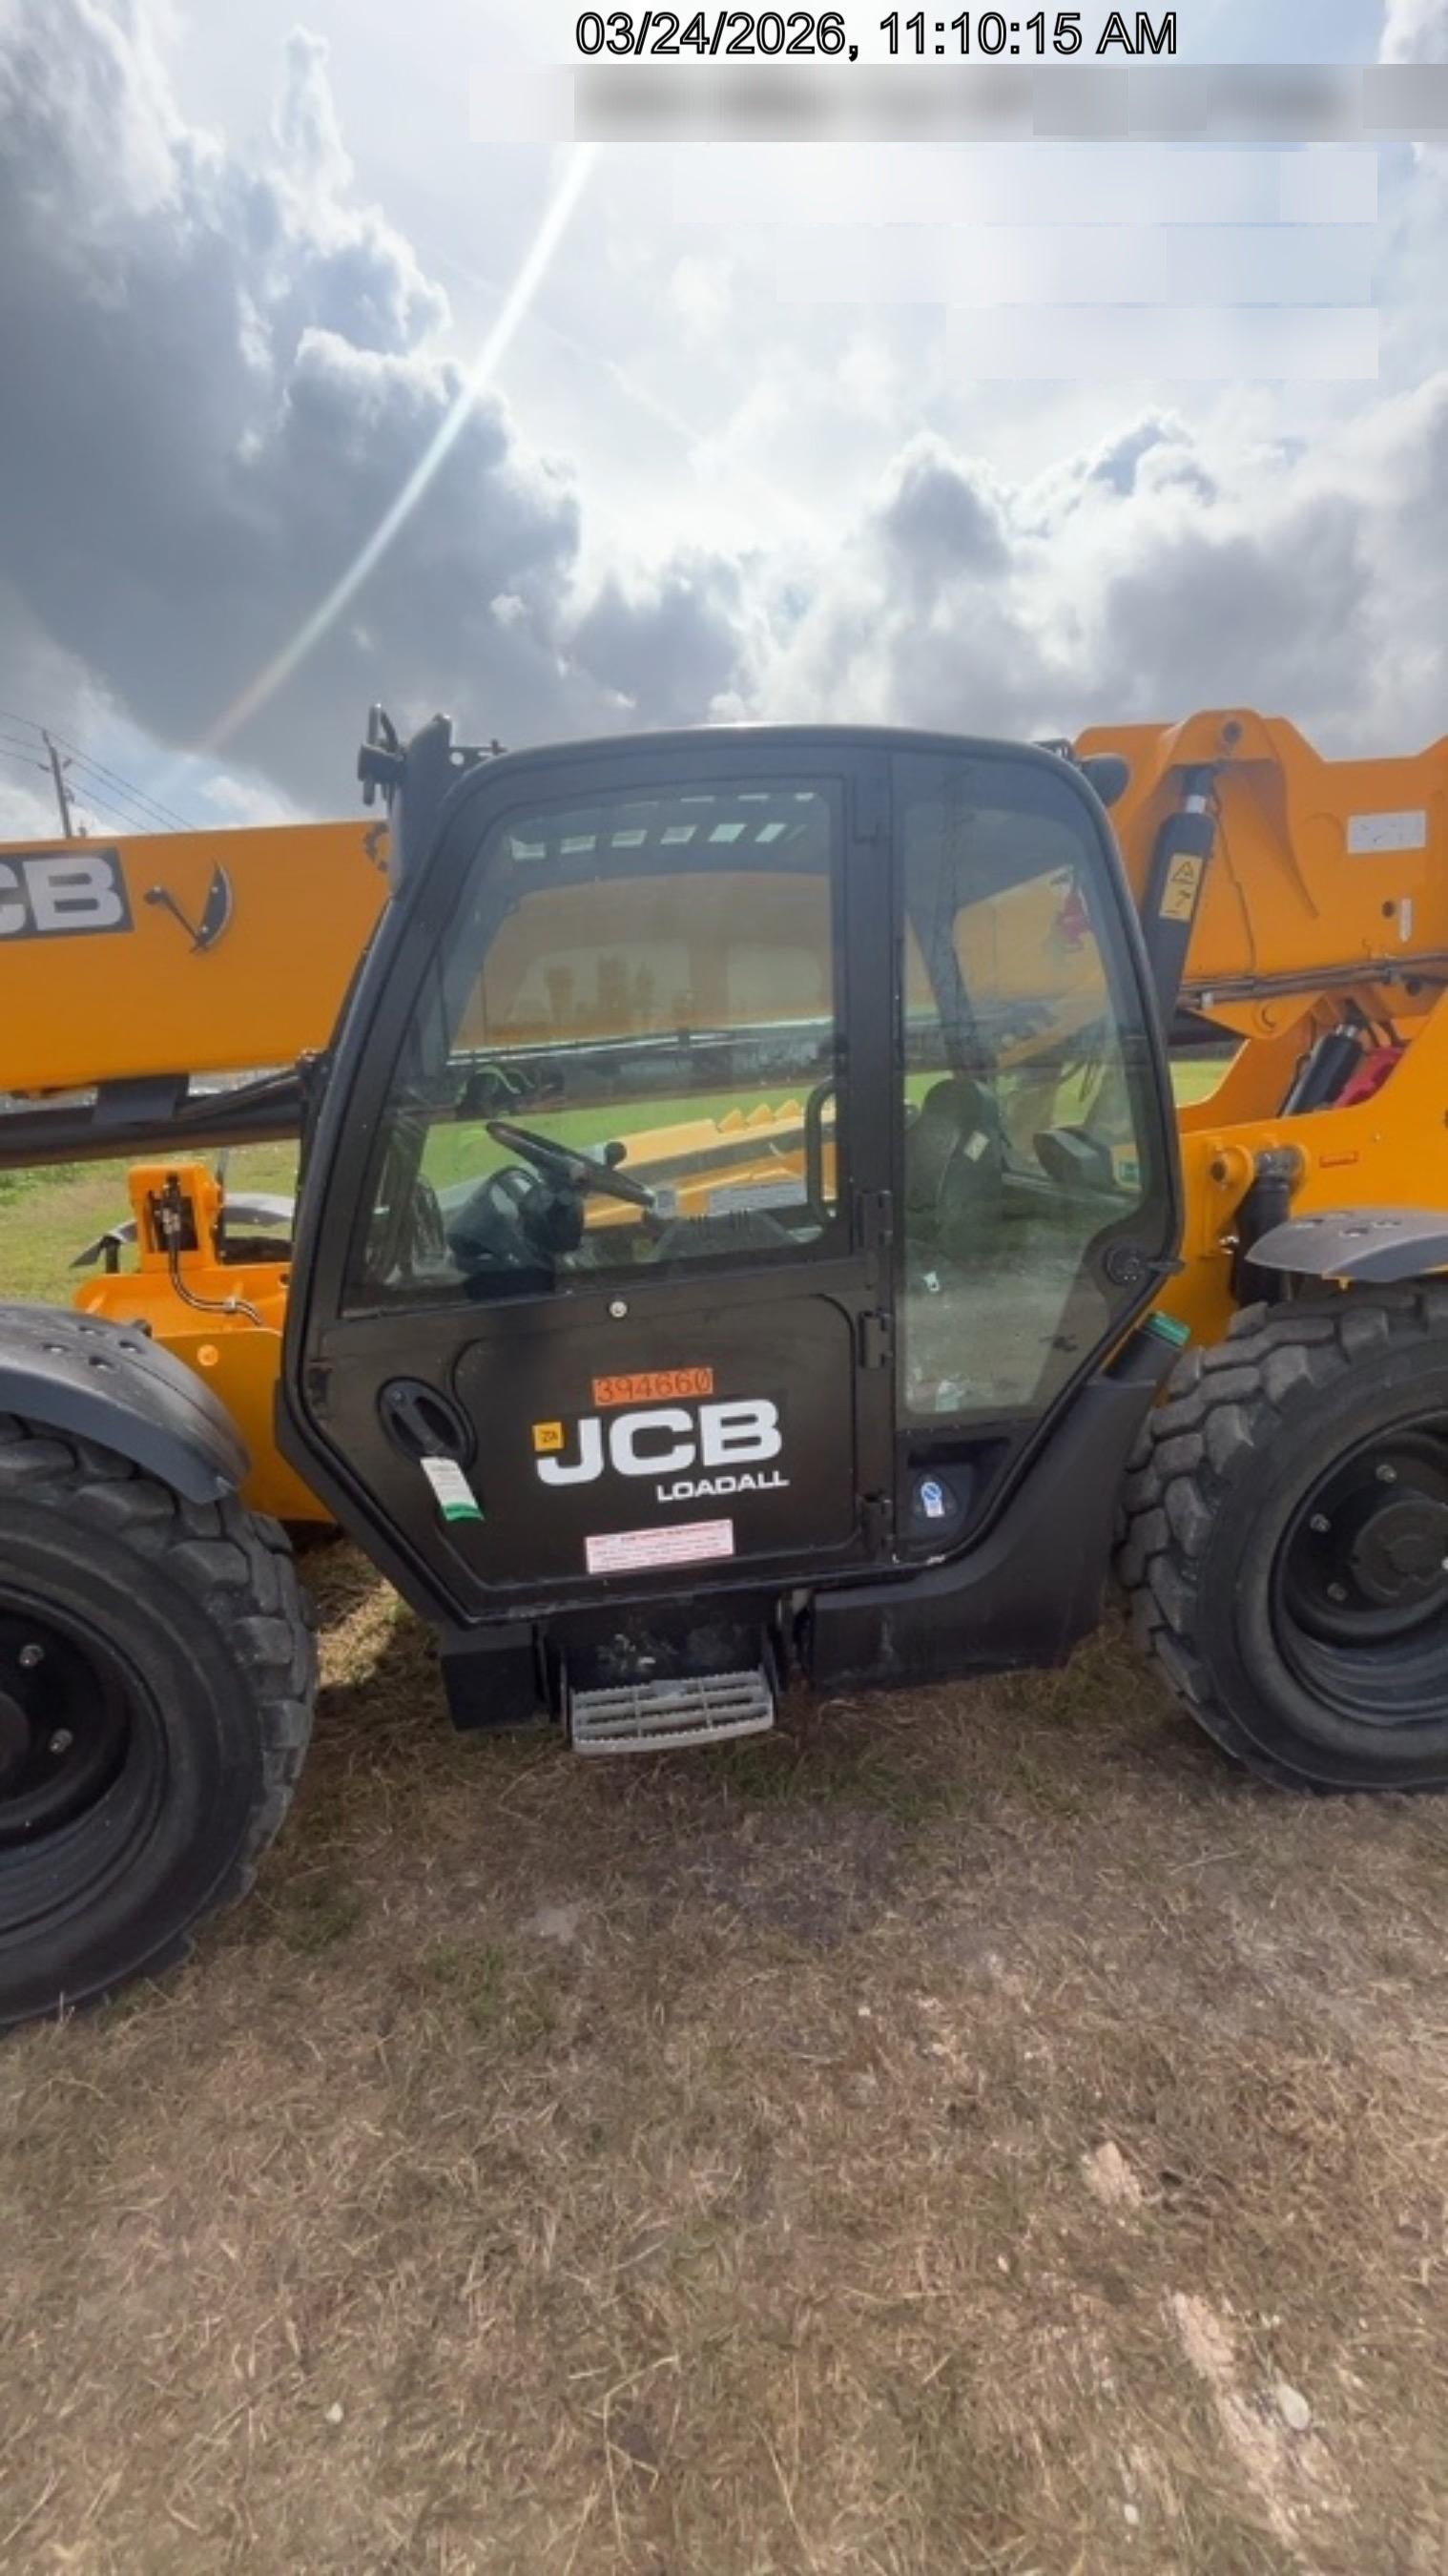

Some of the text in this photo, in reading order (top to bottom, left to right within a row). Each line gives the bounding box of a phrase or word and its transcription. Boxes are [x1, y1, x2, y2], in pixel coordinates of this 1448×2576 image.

[0, 858, 124, 934] B
[537, 1399, 782, 1485] JCB
[656, 1470, 790, 1503] LOADALL
